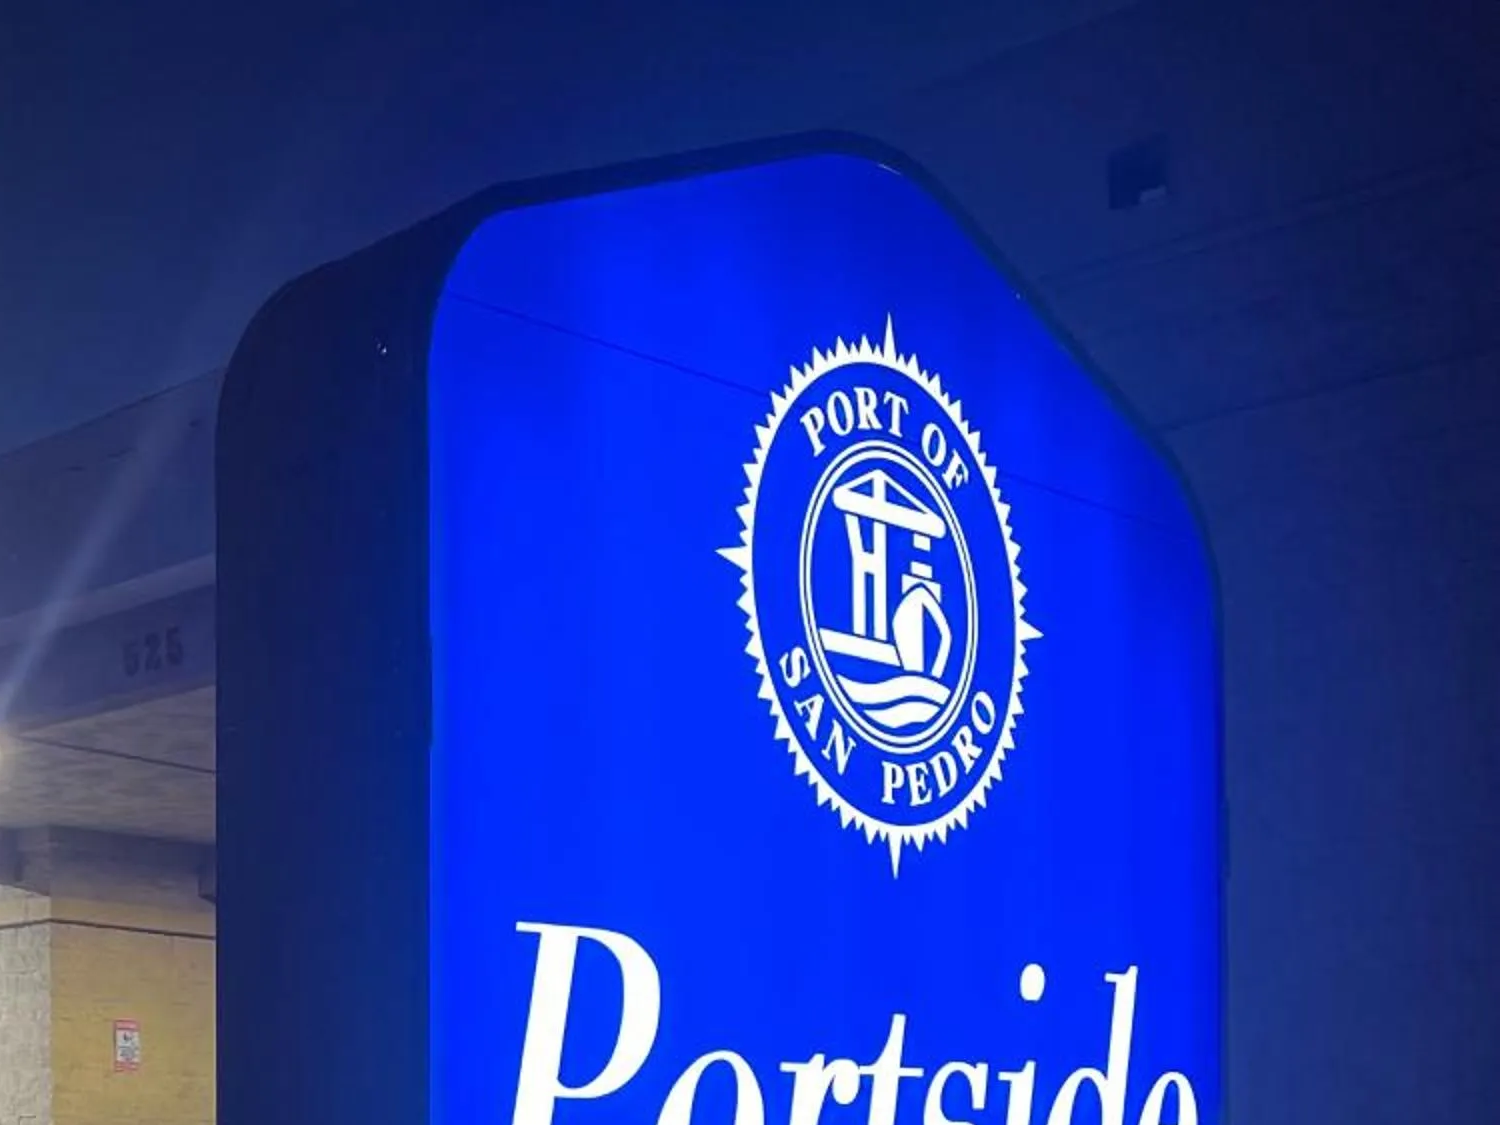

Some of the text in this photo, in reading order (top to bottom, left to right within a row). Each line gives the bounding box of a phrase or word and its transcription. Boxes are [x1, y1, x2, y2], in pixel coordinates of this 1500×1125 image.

[799, 387, 969, 490] PORT OF
[779, 646, 996, 807] SAN PEDRO
